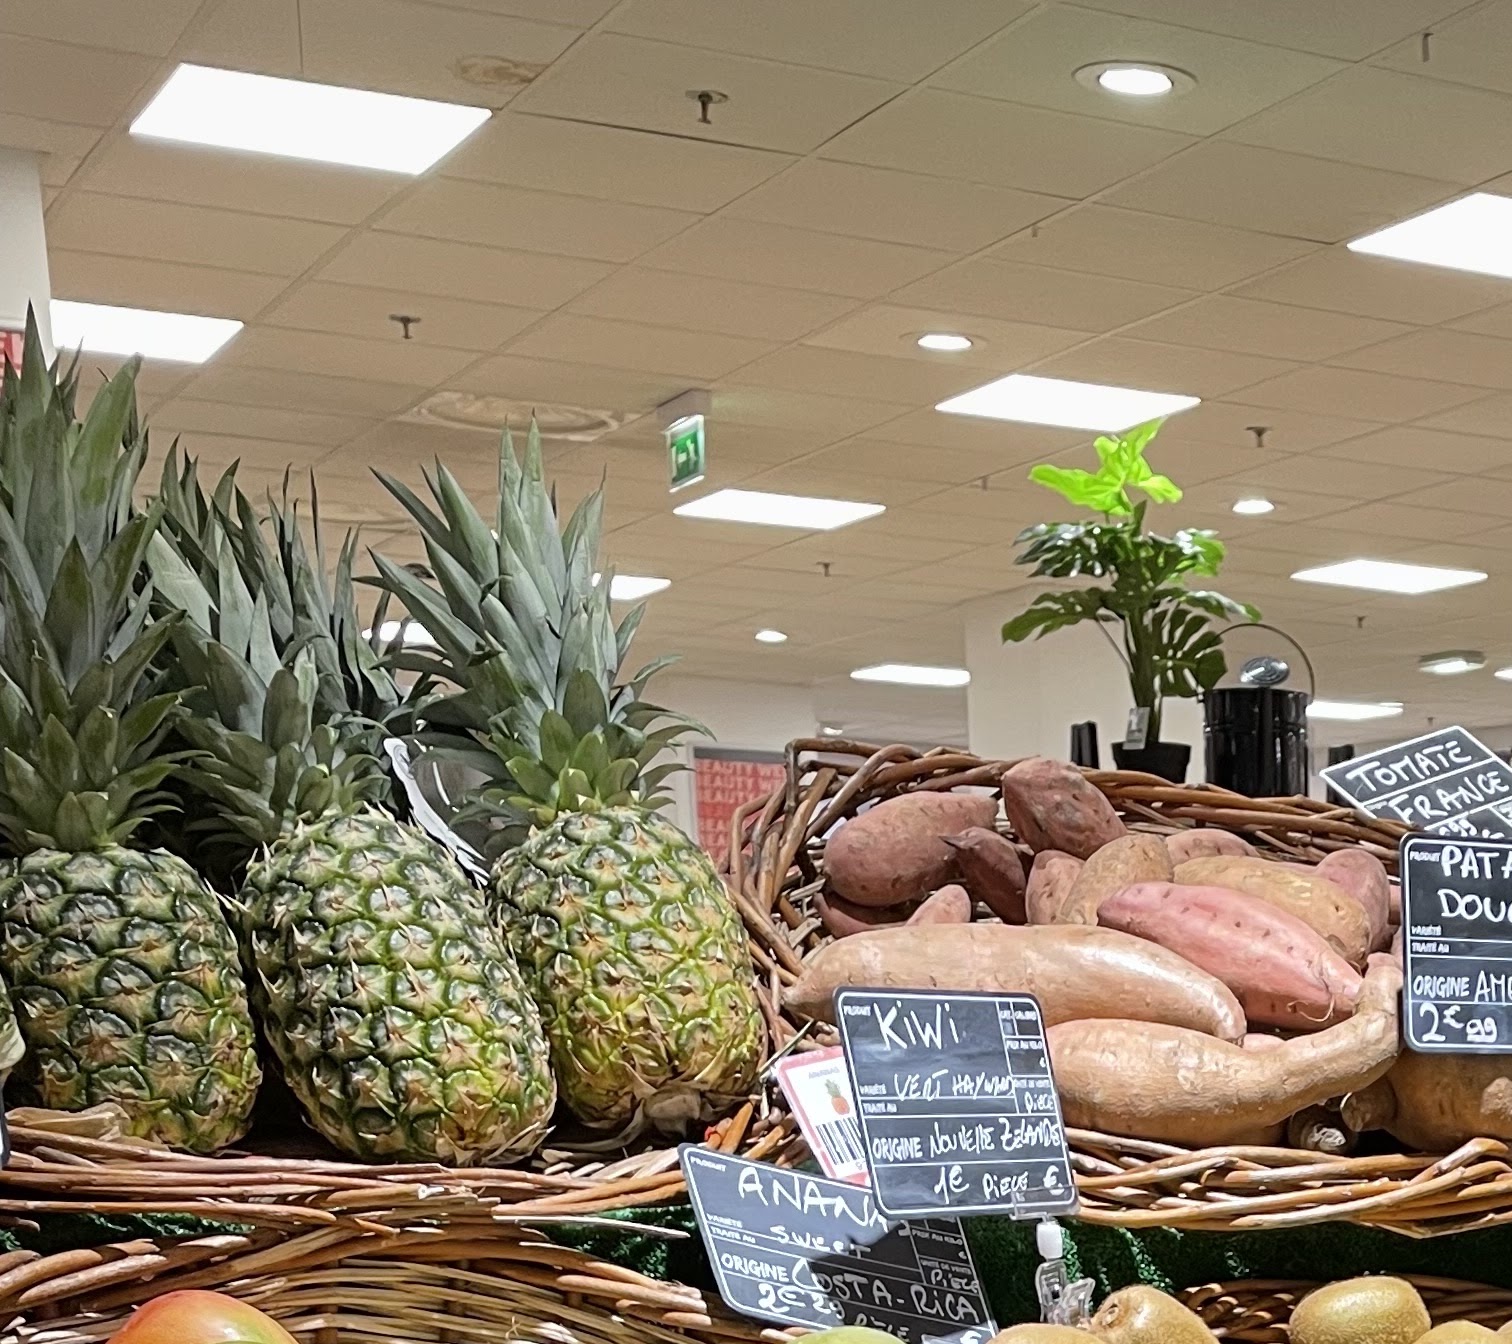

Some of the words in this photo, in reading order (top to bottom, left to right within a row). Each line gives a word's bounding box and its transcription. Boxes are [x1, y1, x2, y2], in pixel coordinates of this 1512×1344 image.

[1346, 741, 1472, 792] TOMATE
[1386, 771, 1509, 826] FRANCE
[1413, 975, 1470, 999] ORIGINE
[873, 1137, 923, 1162] ORIGINE
[720, 1253, 790, 1283] ORIGINE
